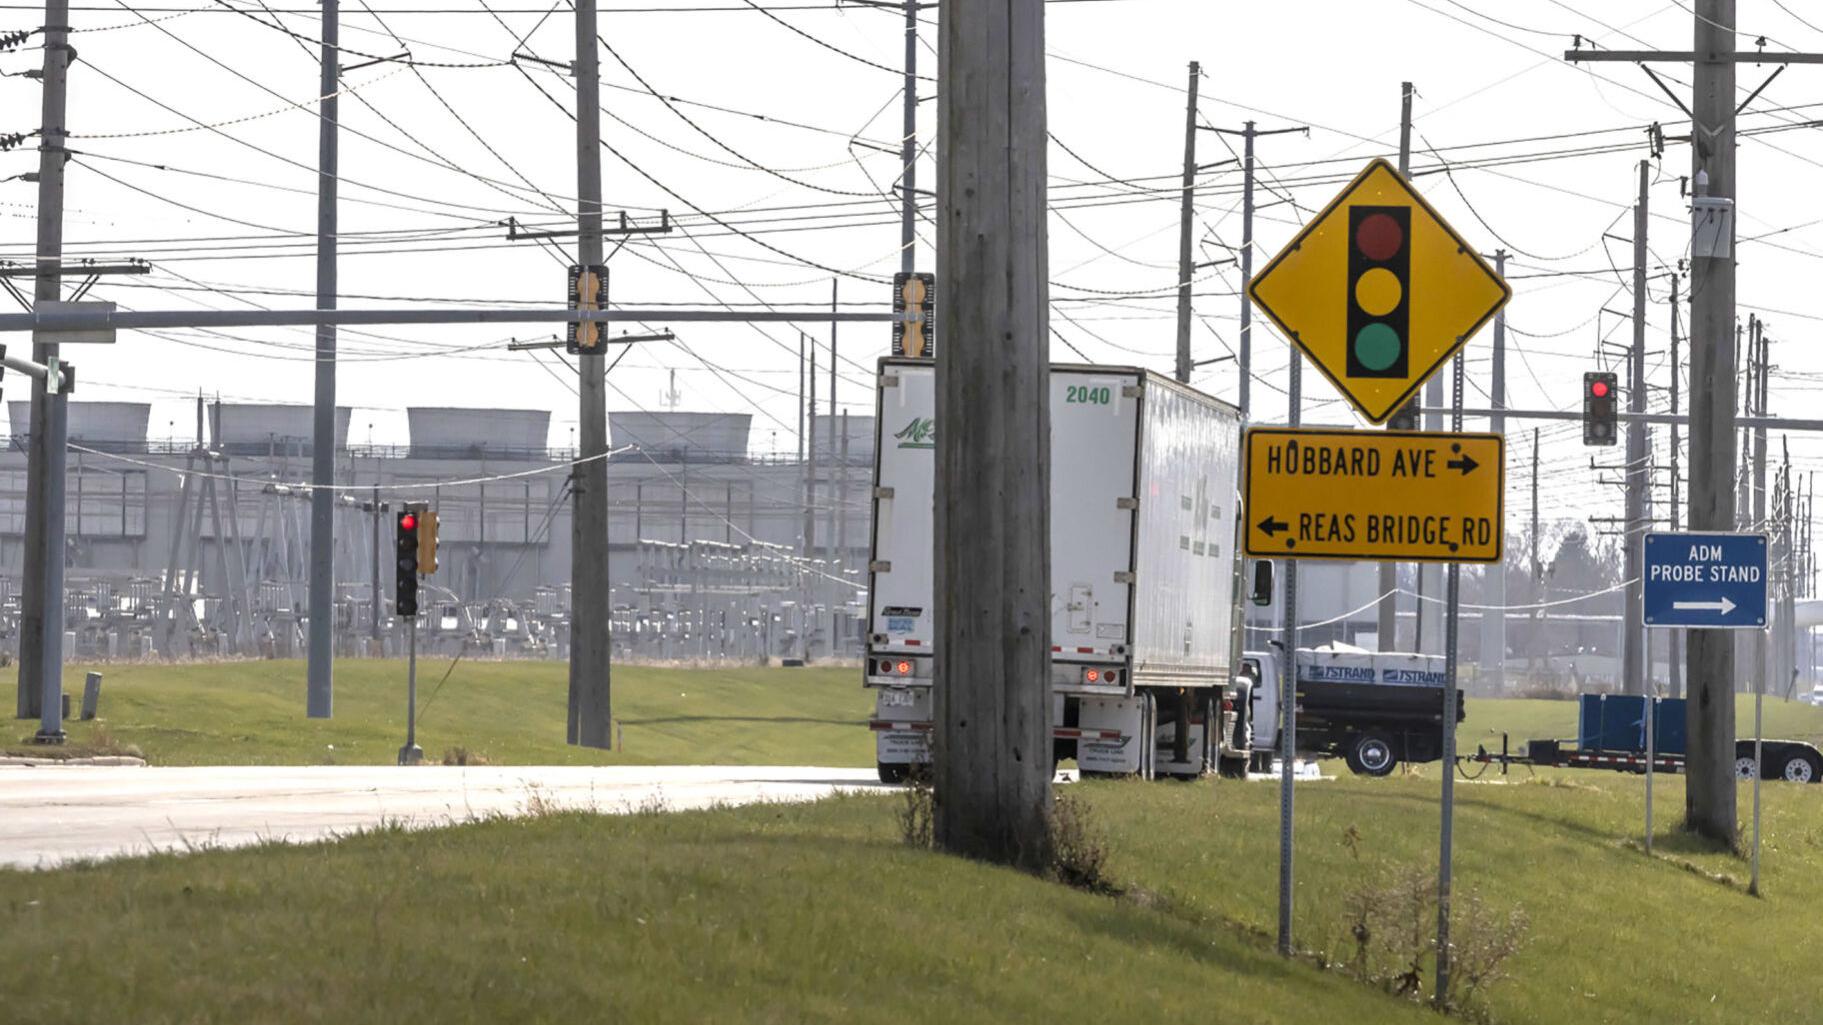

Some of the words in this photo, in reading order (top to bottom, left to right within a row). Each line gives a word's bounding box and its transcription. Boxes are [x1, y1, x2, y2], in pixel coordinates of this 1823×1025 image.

[1066, 386, 1110, 404] 2040
[1268, 446, 1380, 476] HOBBARD
[1392, 449, 1436, 477] AVE
[1300, 513, 1355, 542] REAS
[1367, 515, 1450, 544] BRIDGE
[1462, 517, 1490, 545] RD
[1689, 545, 1722, 561] ADM
[1651, 565, 1703, 582] PROBE
[1710, 566, 1760, 582] STAND
